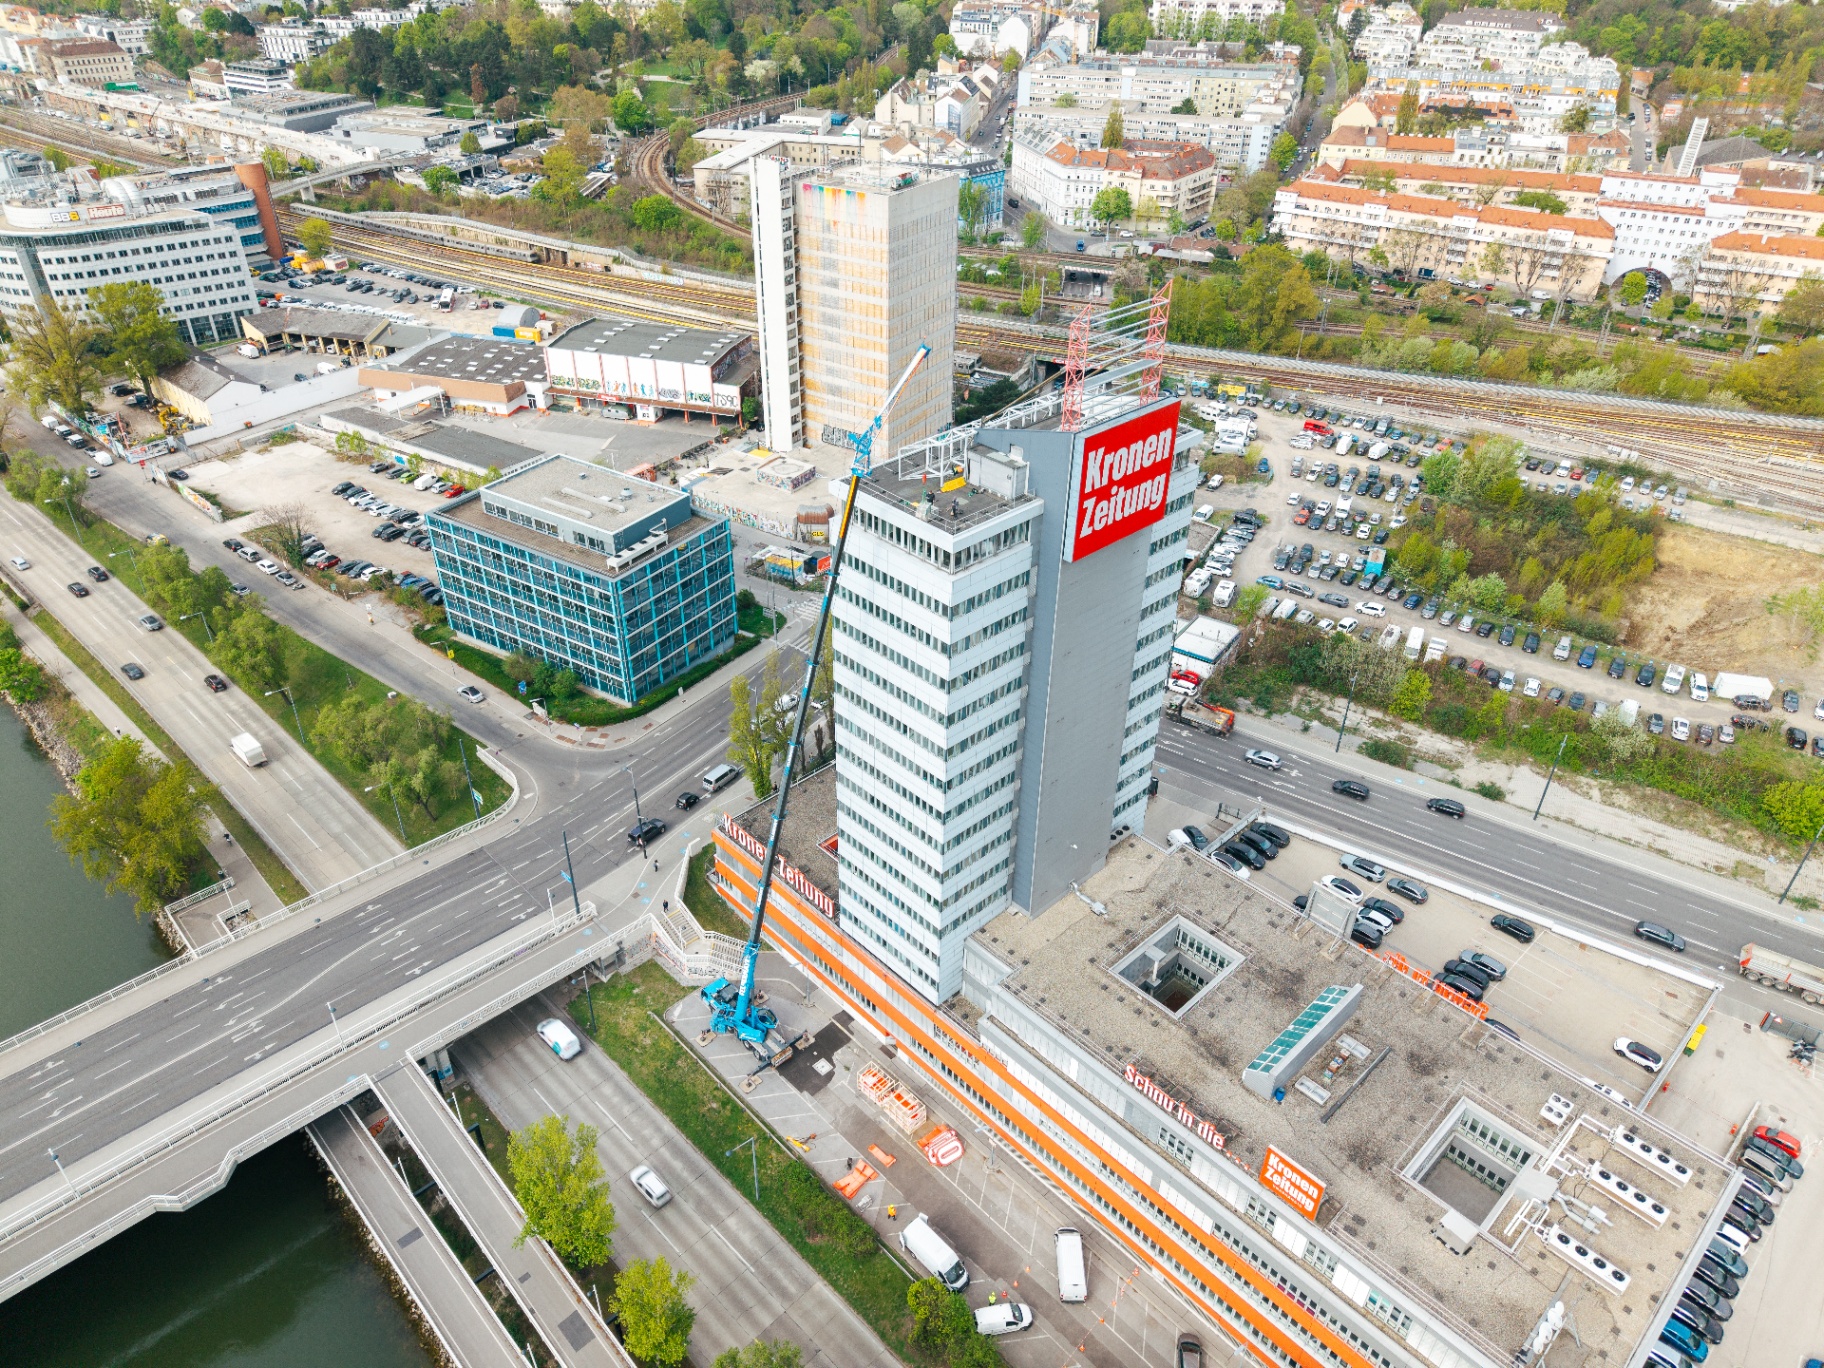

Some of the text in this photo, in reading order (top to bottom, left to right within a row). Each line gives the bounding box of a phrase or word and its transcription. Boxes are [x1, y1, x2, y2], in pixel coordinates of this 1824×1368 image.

[1085, 427, 1173, 494] Kronen
[1079, 473, 1166, 538] Zeitung
[778, 853, 835, 919] Zeitung
[1124, 1063, 1175, 1112] Schau
[1178, 1102, 1195, 1128] in
[1264, 1165, 1314, 1212] Zeitung
[1267, 1152, 1319, 1200] Kronen
